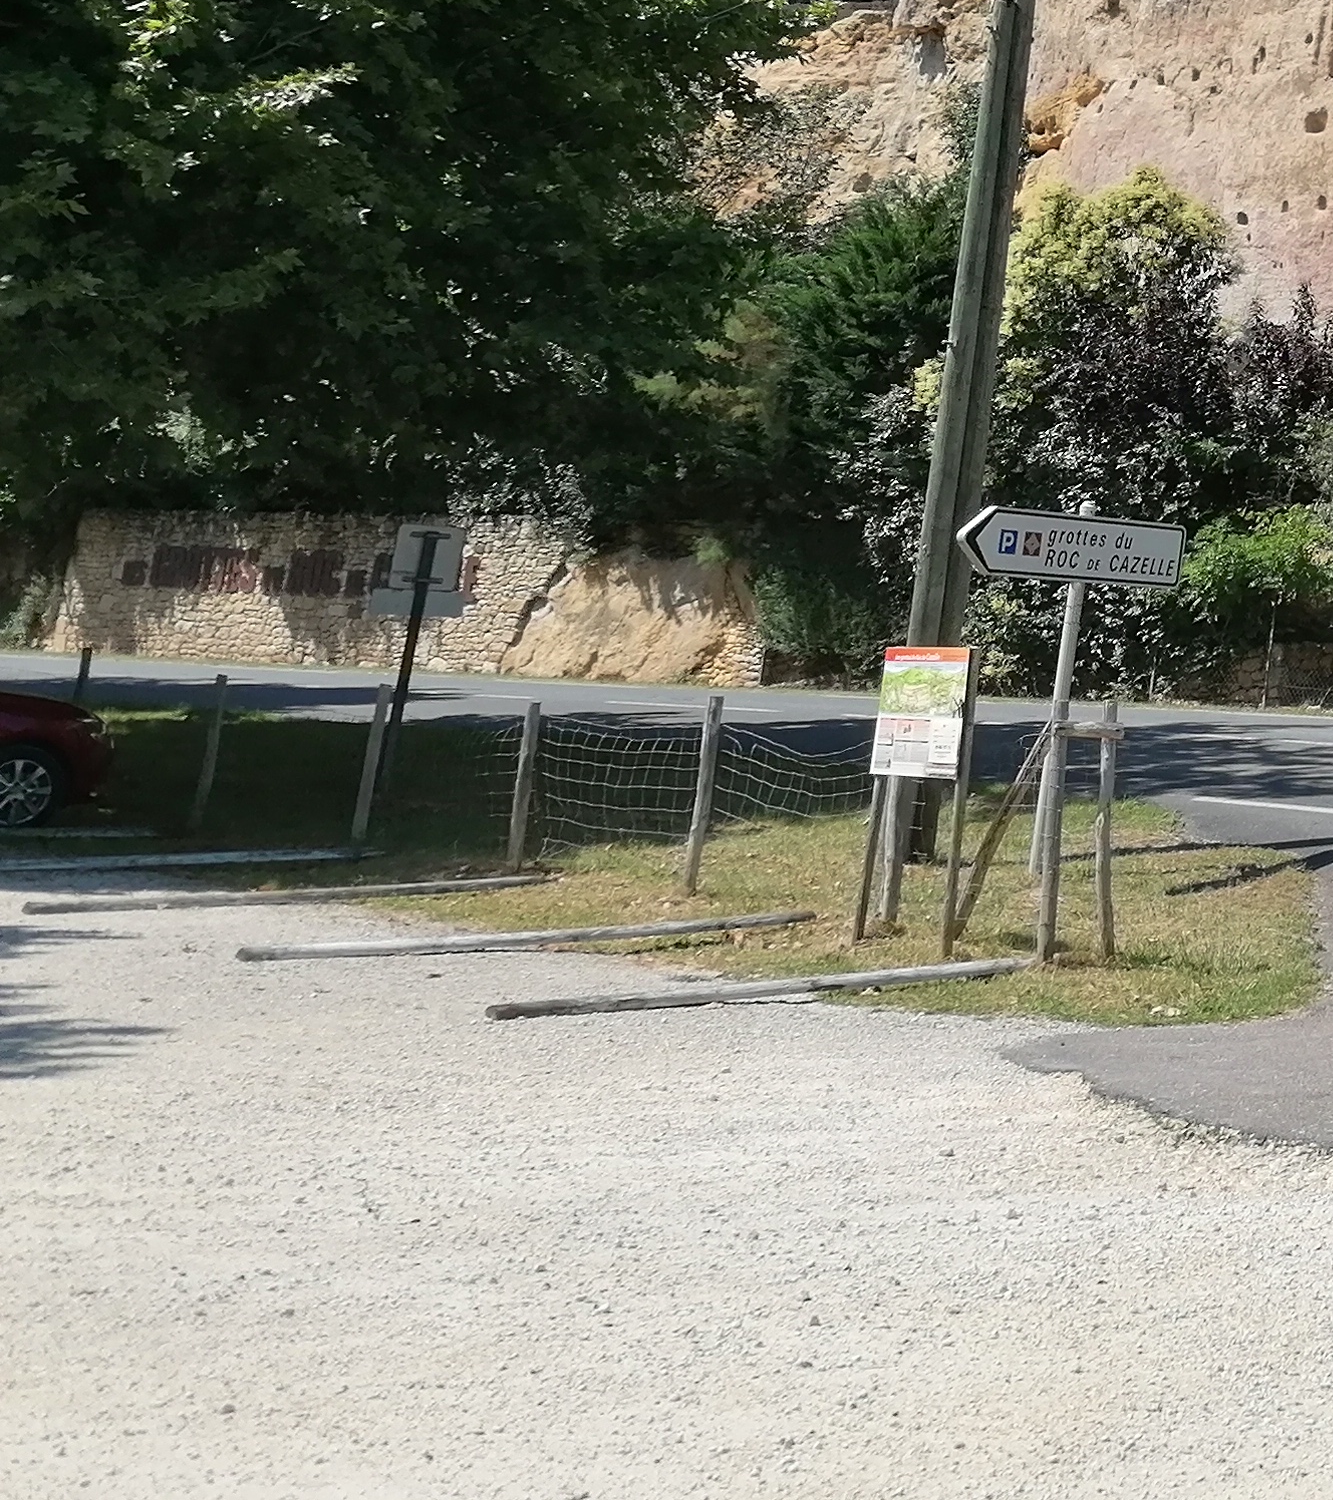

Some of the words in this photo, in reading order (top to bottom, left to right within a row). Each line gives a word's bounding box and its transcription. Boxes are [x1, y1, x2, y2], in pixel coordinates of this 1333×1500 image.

[1001, 531, 1016, 552] P
[1047, 529, 1107, 548] grottes
[1115, 532, 1134, 550] du
[1044, 549, 1081, 569] ROC
[1087, 559, 1102, 572] DE
[1110, 555, 1176, 577] CAZELLE
